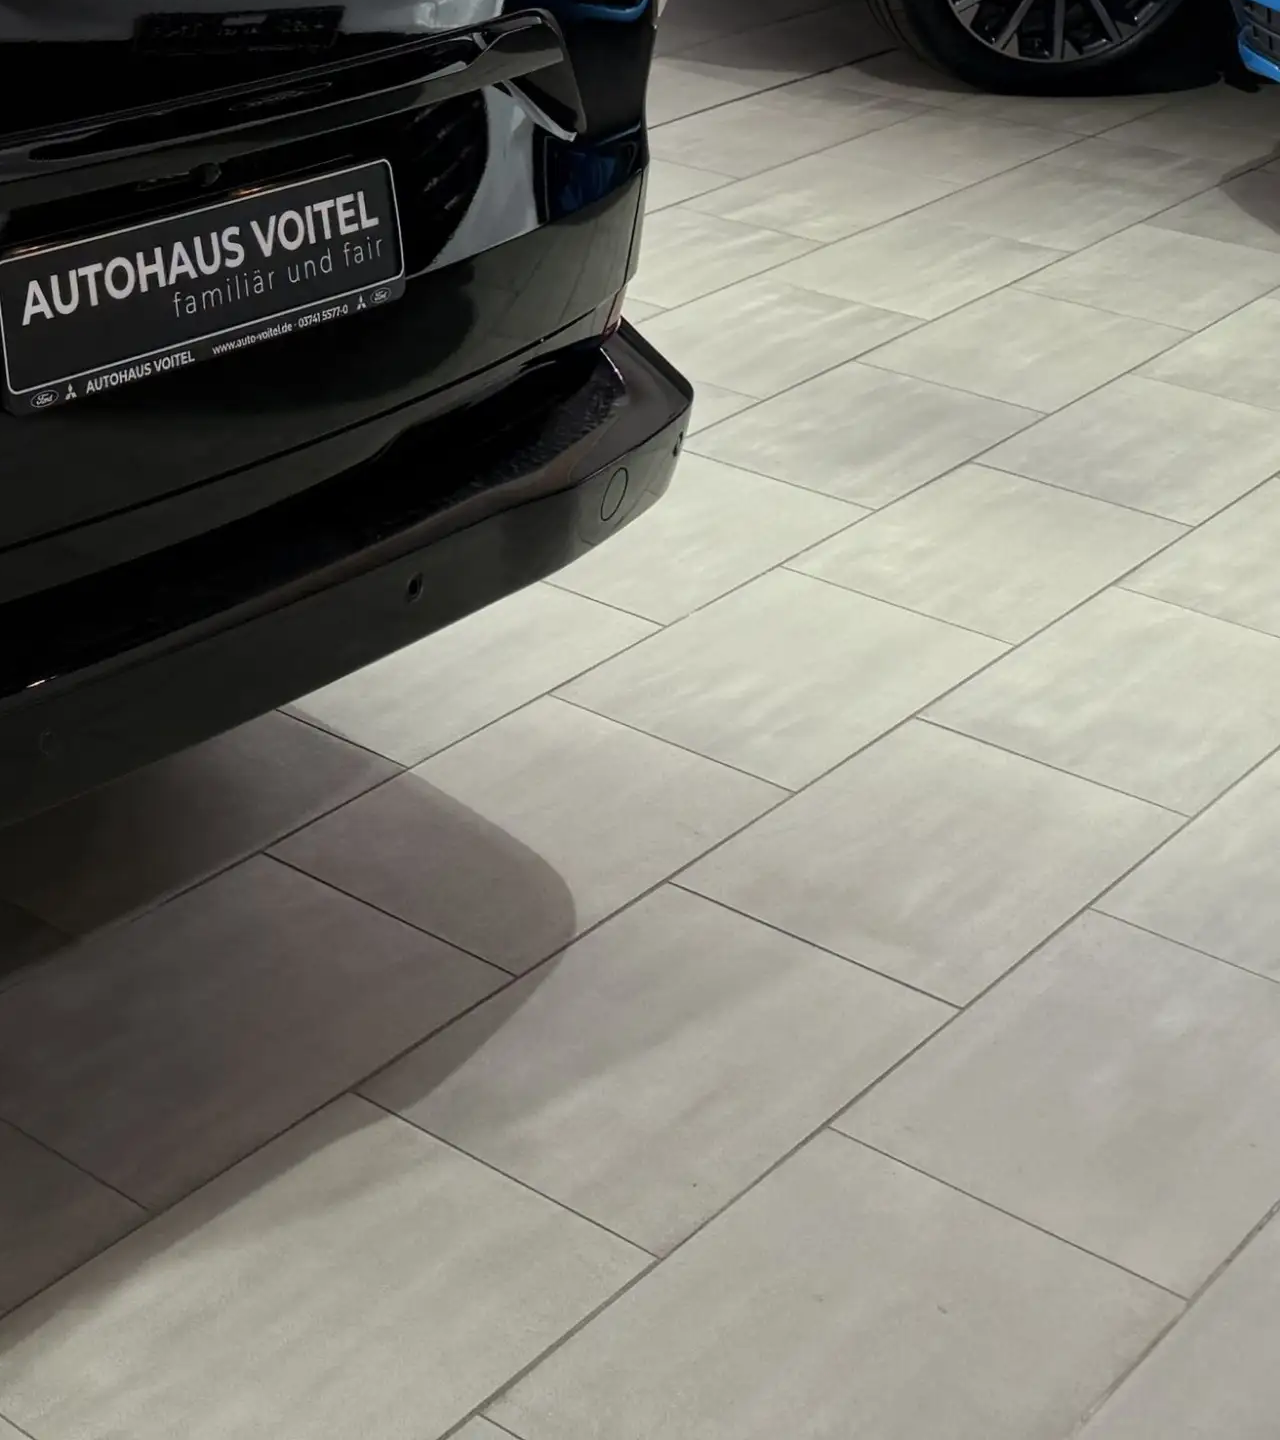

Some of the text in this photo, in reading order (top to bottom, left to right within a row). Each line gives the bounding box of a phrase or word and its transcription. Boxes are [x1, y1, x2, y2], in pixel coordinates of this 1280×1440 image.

[22, 191, 380, 326] AUTOHAUS VOITEL
[174, 236, 383, 317] familiär und fair
[86, 362, 152, 394] AUTOHAUS
[153, 351, 195, 372] VOITEL
[212, 322, 293, 355] www.auto-voitel.de
[298, 313, 321, 329] 03741
[322, 304, 349, 322] 5577-0
